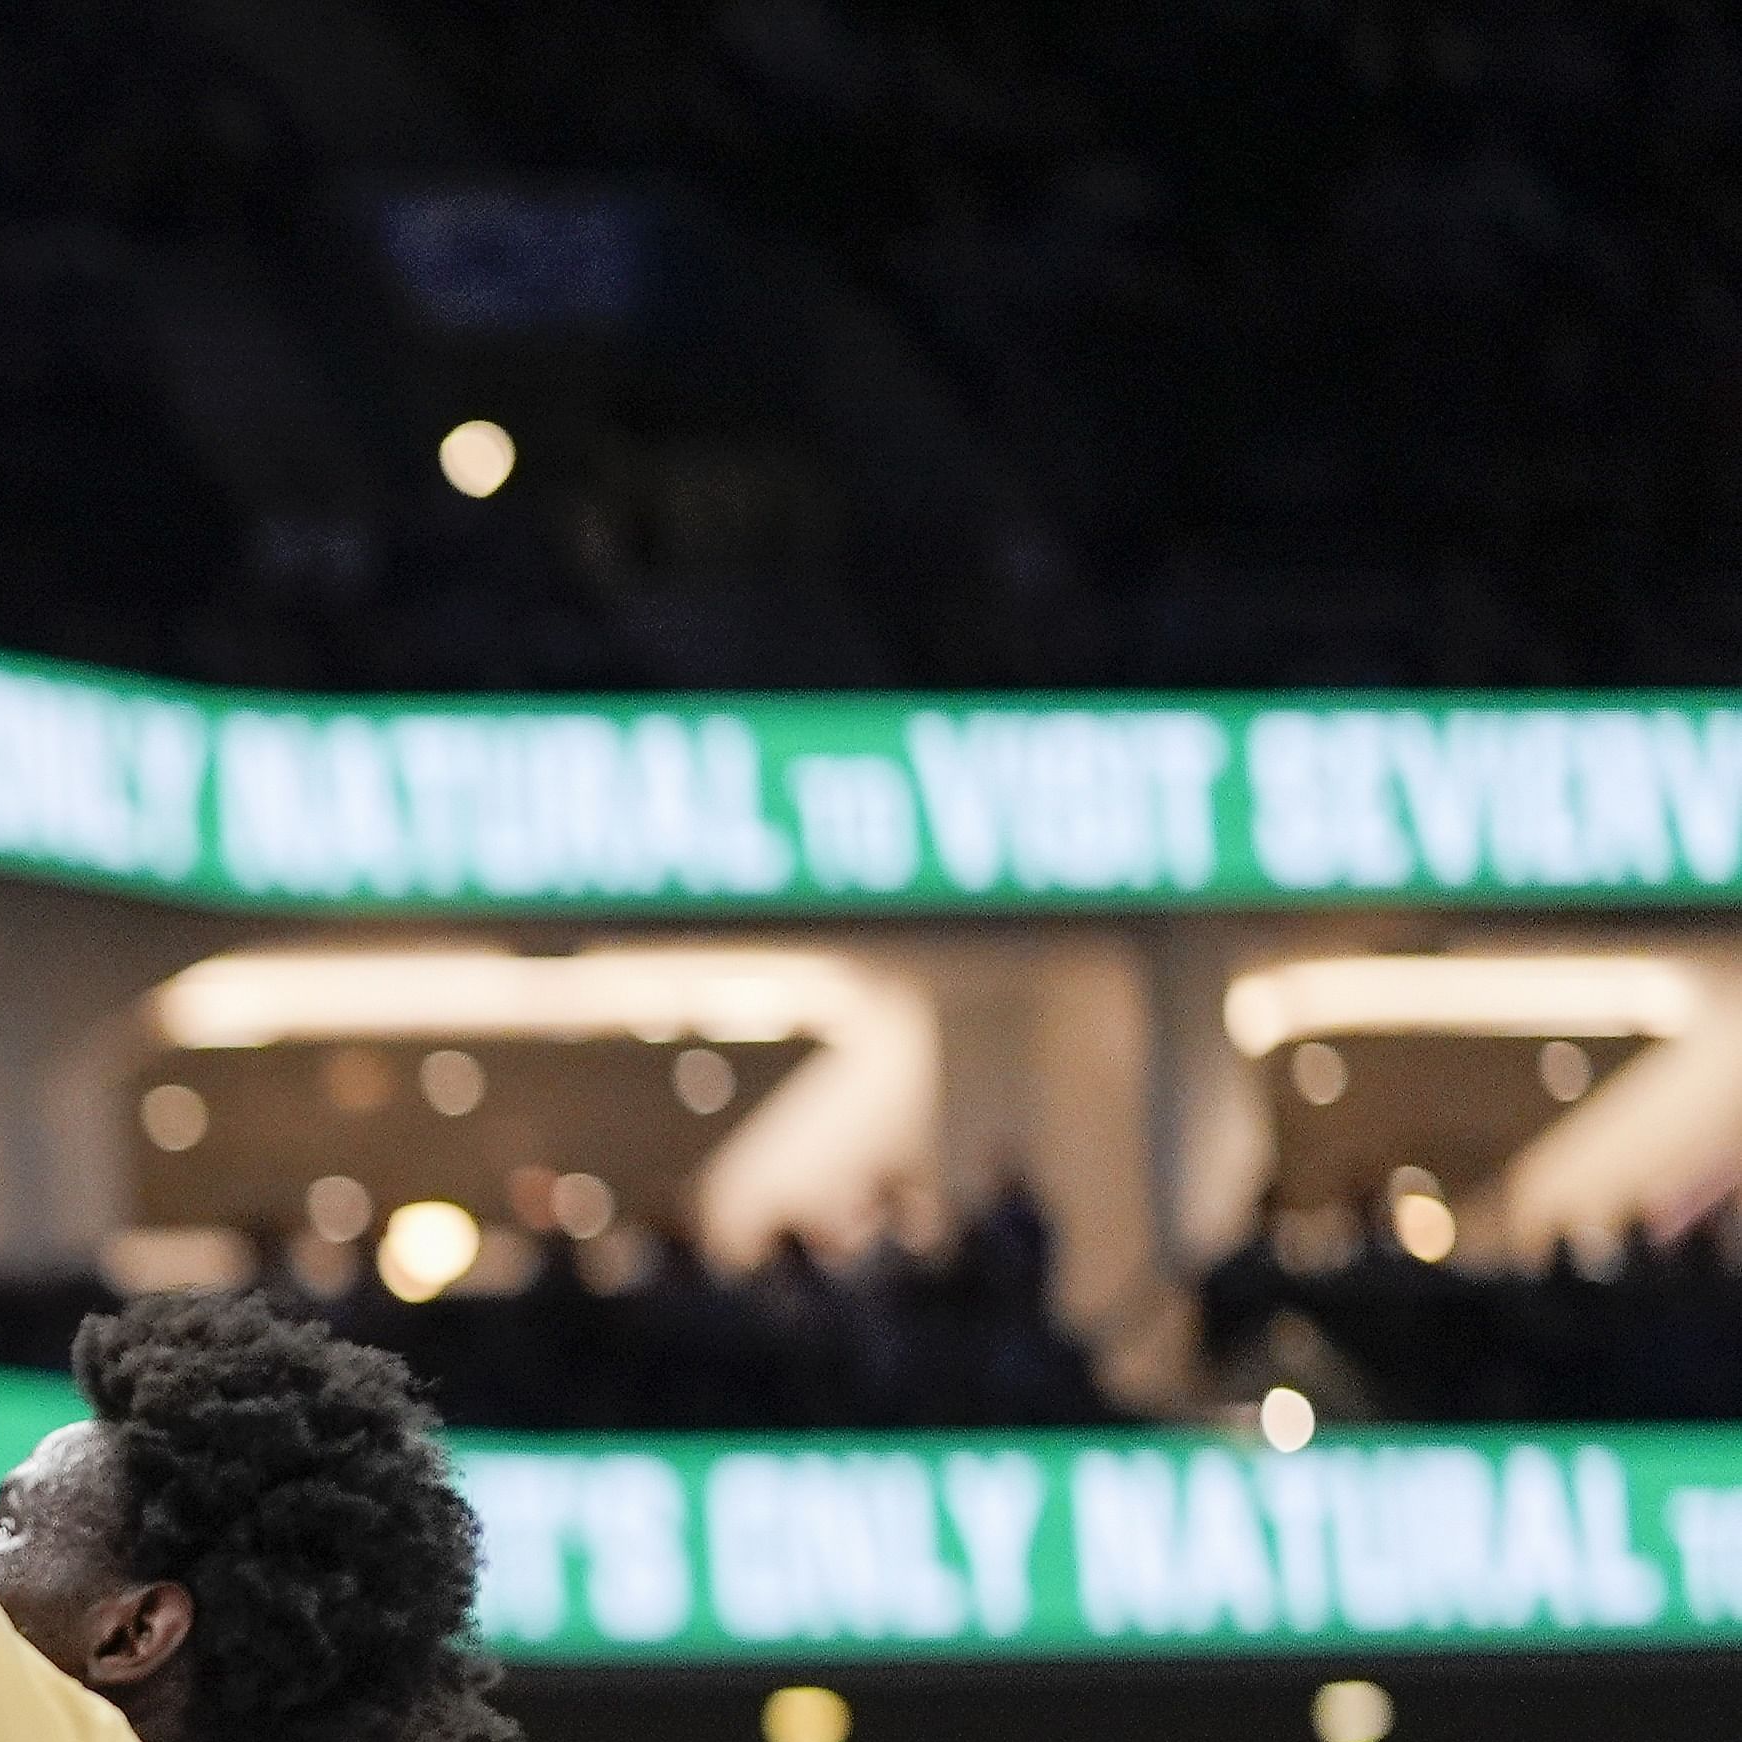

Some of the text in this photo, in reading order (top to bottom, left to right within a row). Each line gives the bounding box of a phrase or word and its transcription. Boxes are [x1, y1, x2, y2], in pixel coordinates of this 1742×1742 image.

[215, 708, 793, 898] NATURAL
[904, 710, 1225, 890] VISIT
[704, 1450, 1046, 1640] ONLY
[1070, 1446, 1666, 1634] NATURAL
